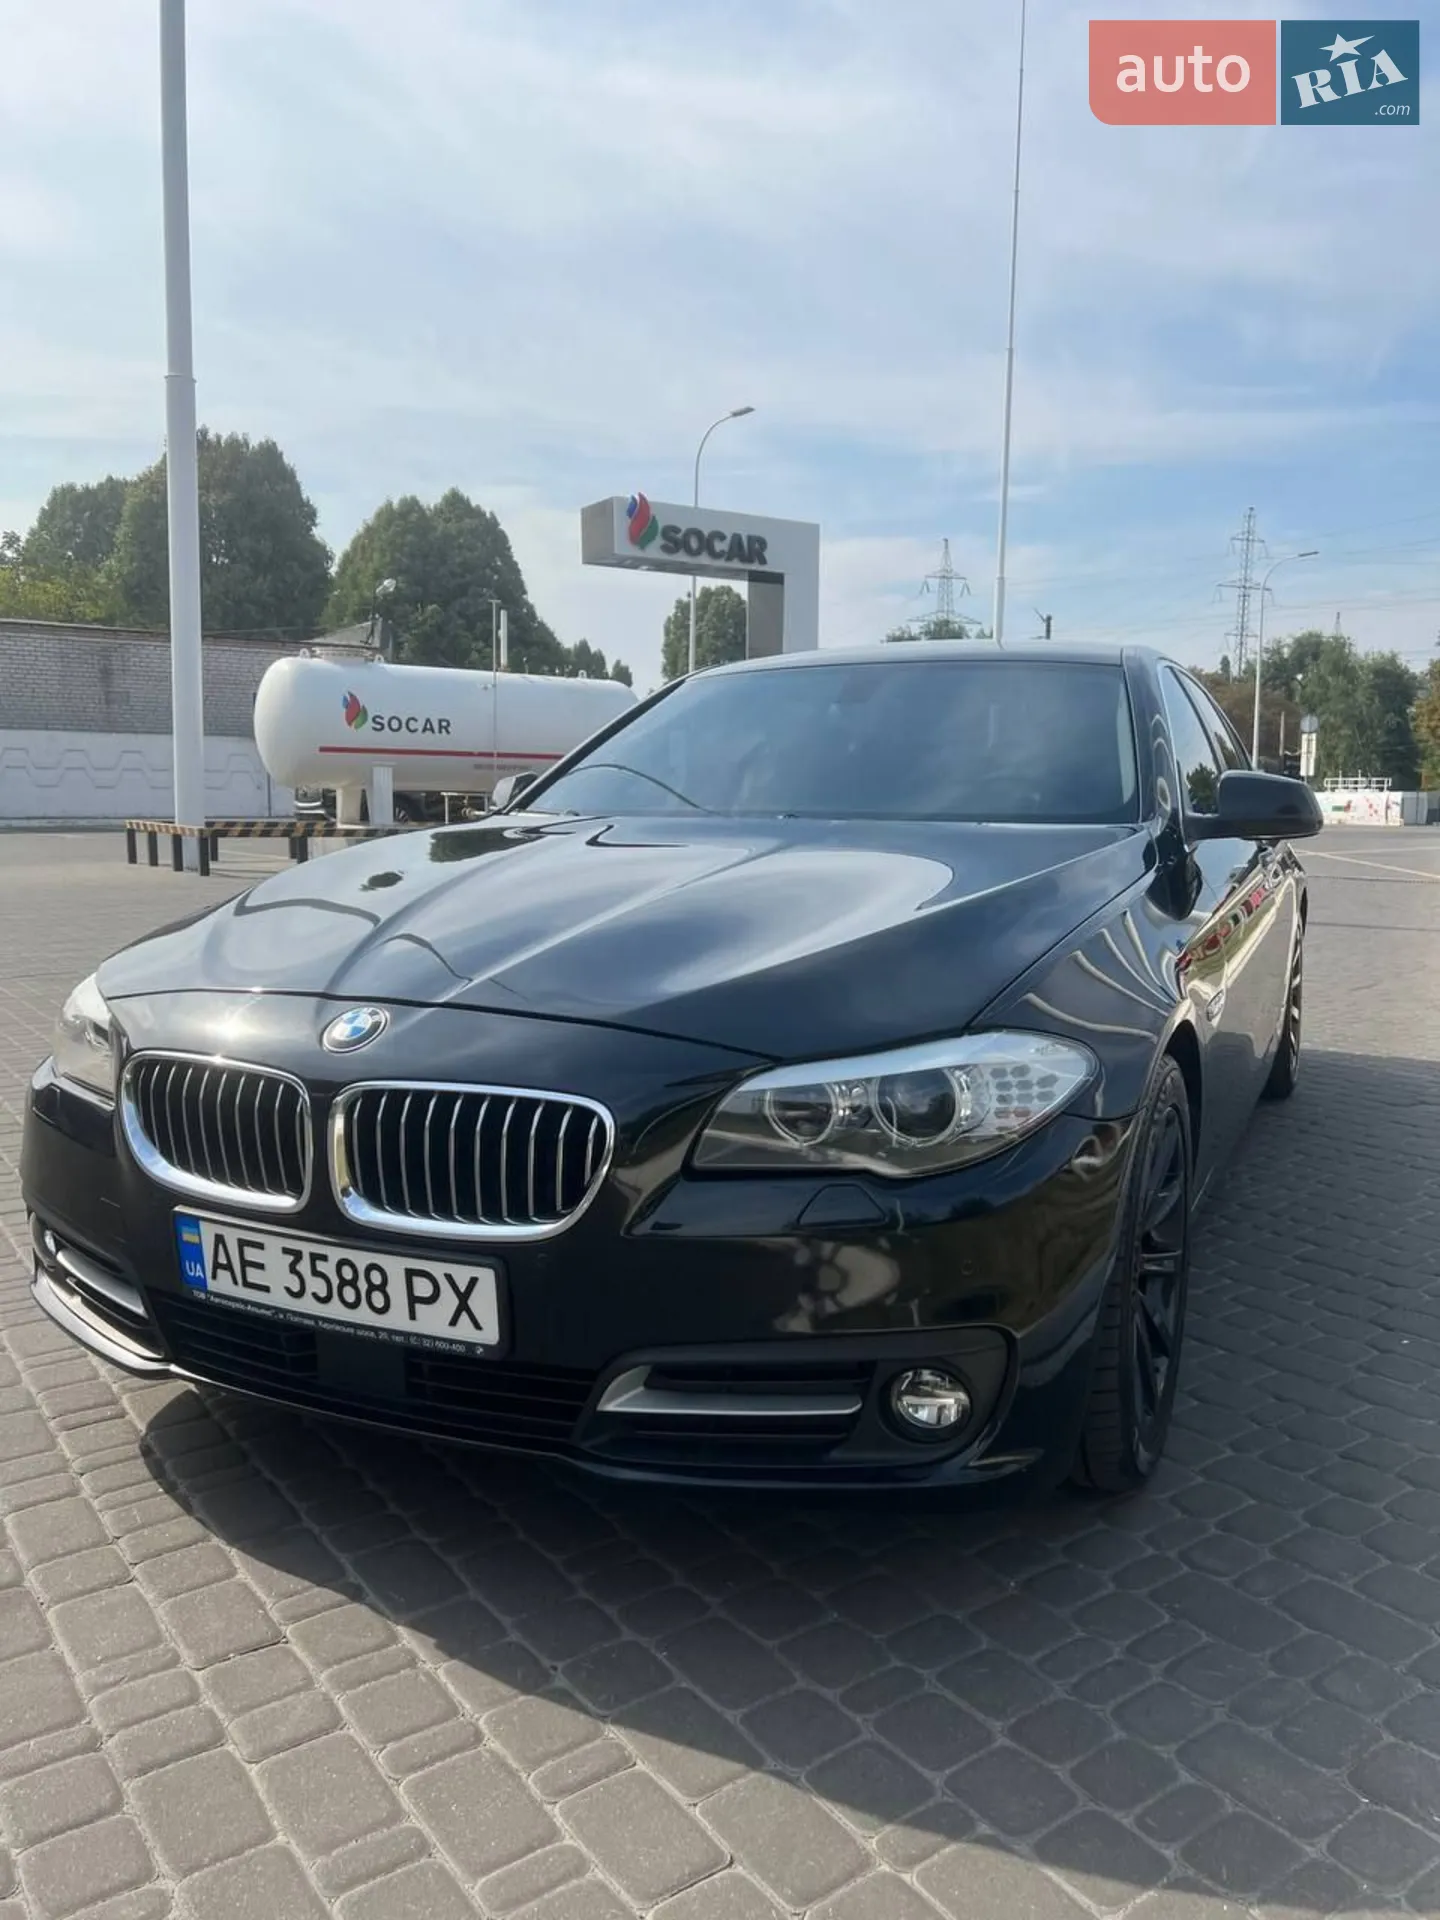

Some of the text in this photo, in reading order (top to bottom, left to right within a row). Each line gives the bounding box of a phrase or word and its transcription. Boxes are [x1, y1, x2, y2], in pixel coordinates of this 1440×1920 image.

[660, 524, 768, 566] SOCAR
[371, 715, 451, 735] SOCAR
[185, 1260, 205, 1279] UA
[211, 1233, 483, 1331] AE 3588 PX
